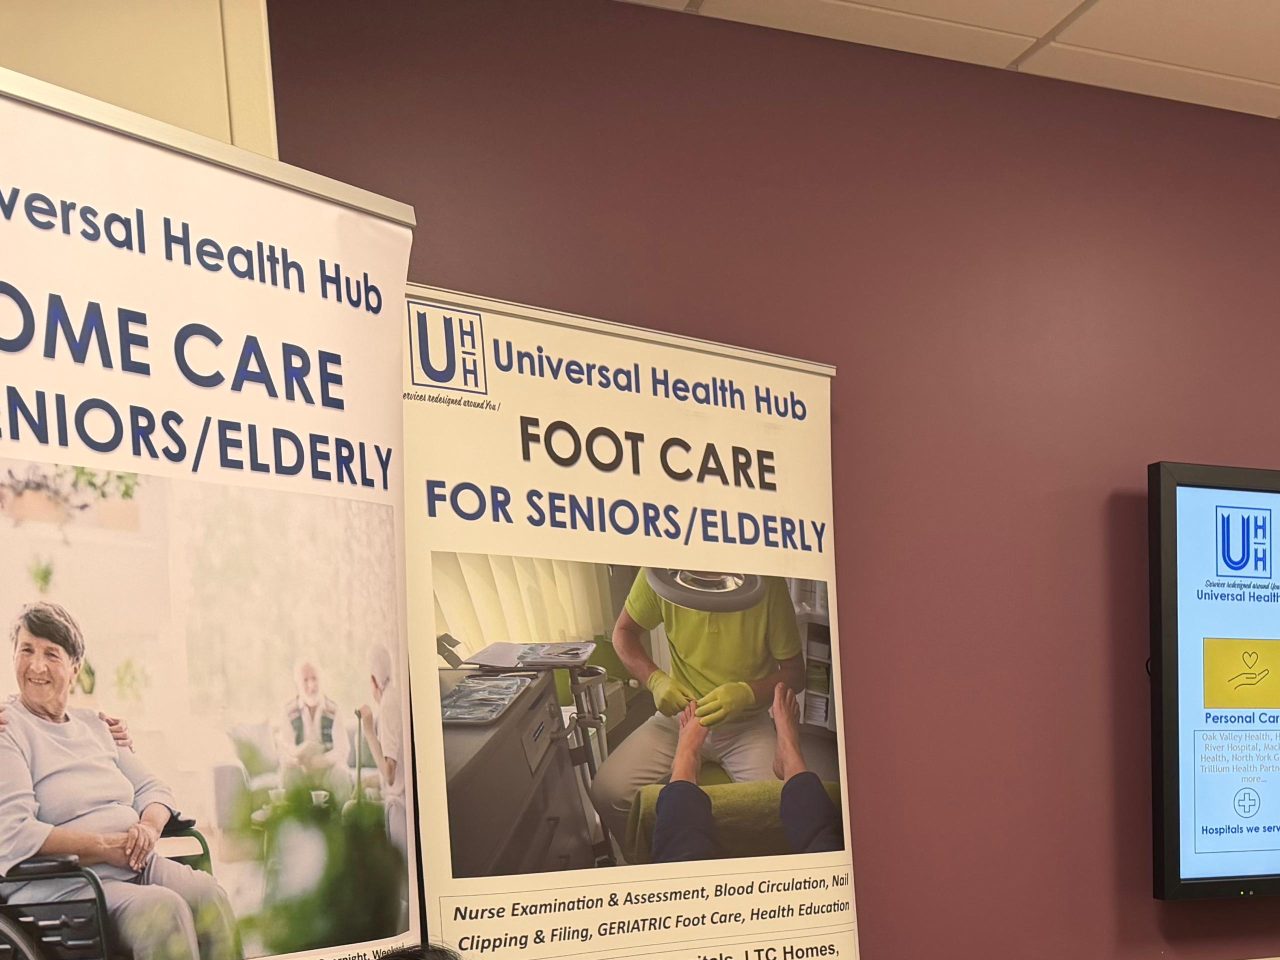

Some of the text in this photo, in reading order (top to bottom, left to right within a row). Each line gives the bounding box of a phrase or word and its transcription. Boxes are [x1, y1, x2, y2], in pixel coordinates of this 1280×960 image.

[163, 217, 305, 293] Health
[318, 259, 383, 315] Hub
[174, 323, 345, 410] CARE
[492, 338, 807, 421] Universal Health Hub
[0, 385, 393, 490] NIORS/ELDERLY
[520, 415, 777, 491] FOOT CARE
[426, 479, 826, 553] FOR SENIORS/ELDERLY
[1196, 589, 1245, 602] Universal
[1205, 712, 1255, 724] Personal
[1202, 733, 1217, 741] Oak
[1219, 733, 1243, 743] Valley
[1204, 743, 1224, 751] River
[1232, 753, 1253, 762] North
[1255, 753, 1272, 762] York
[1232, 764, 1257, 773] Health
[1202, 824, 1243, 836] Hospitals
[1246, 824, 1260, 833] we
[453, 873, 849, 921] Nurse Examination & Assessment, Blood Circulation, Nail
[458, 899, 849, 953] Clipping & Filing, GERIATRIC Foot Care, Health Education
[783, 943, 840, 960] Homes,
